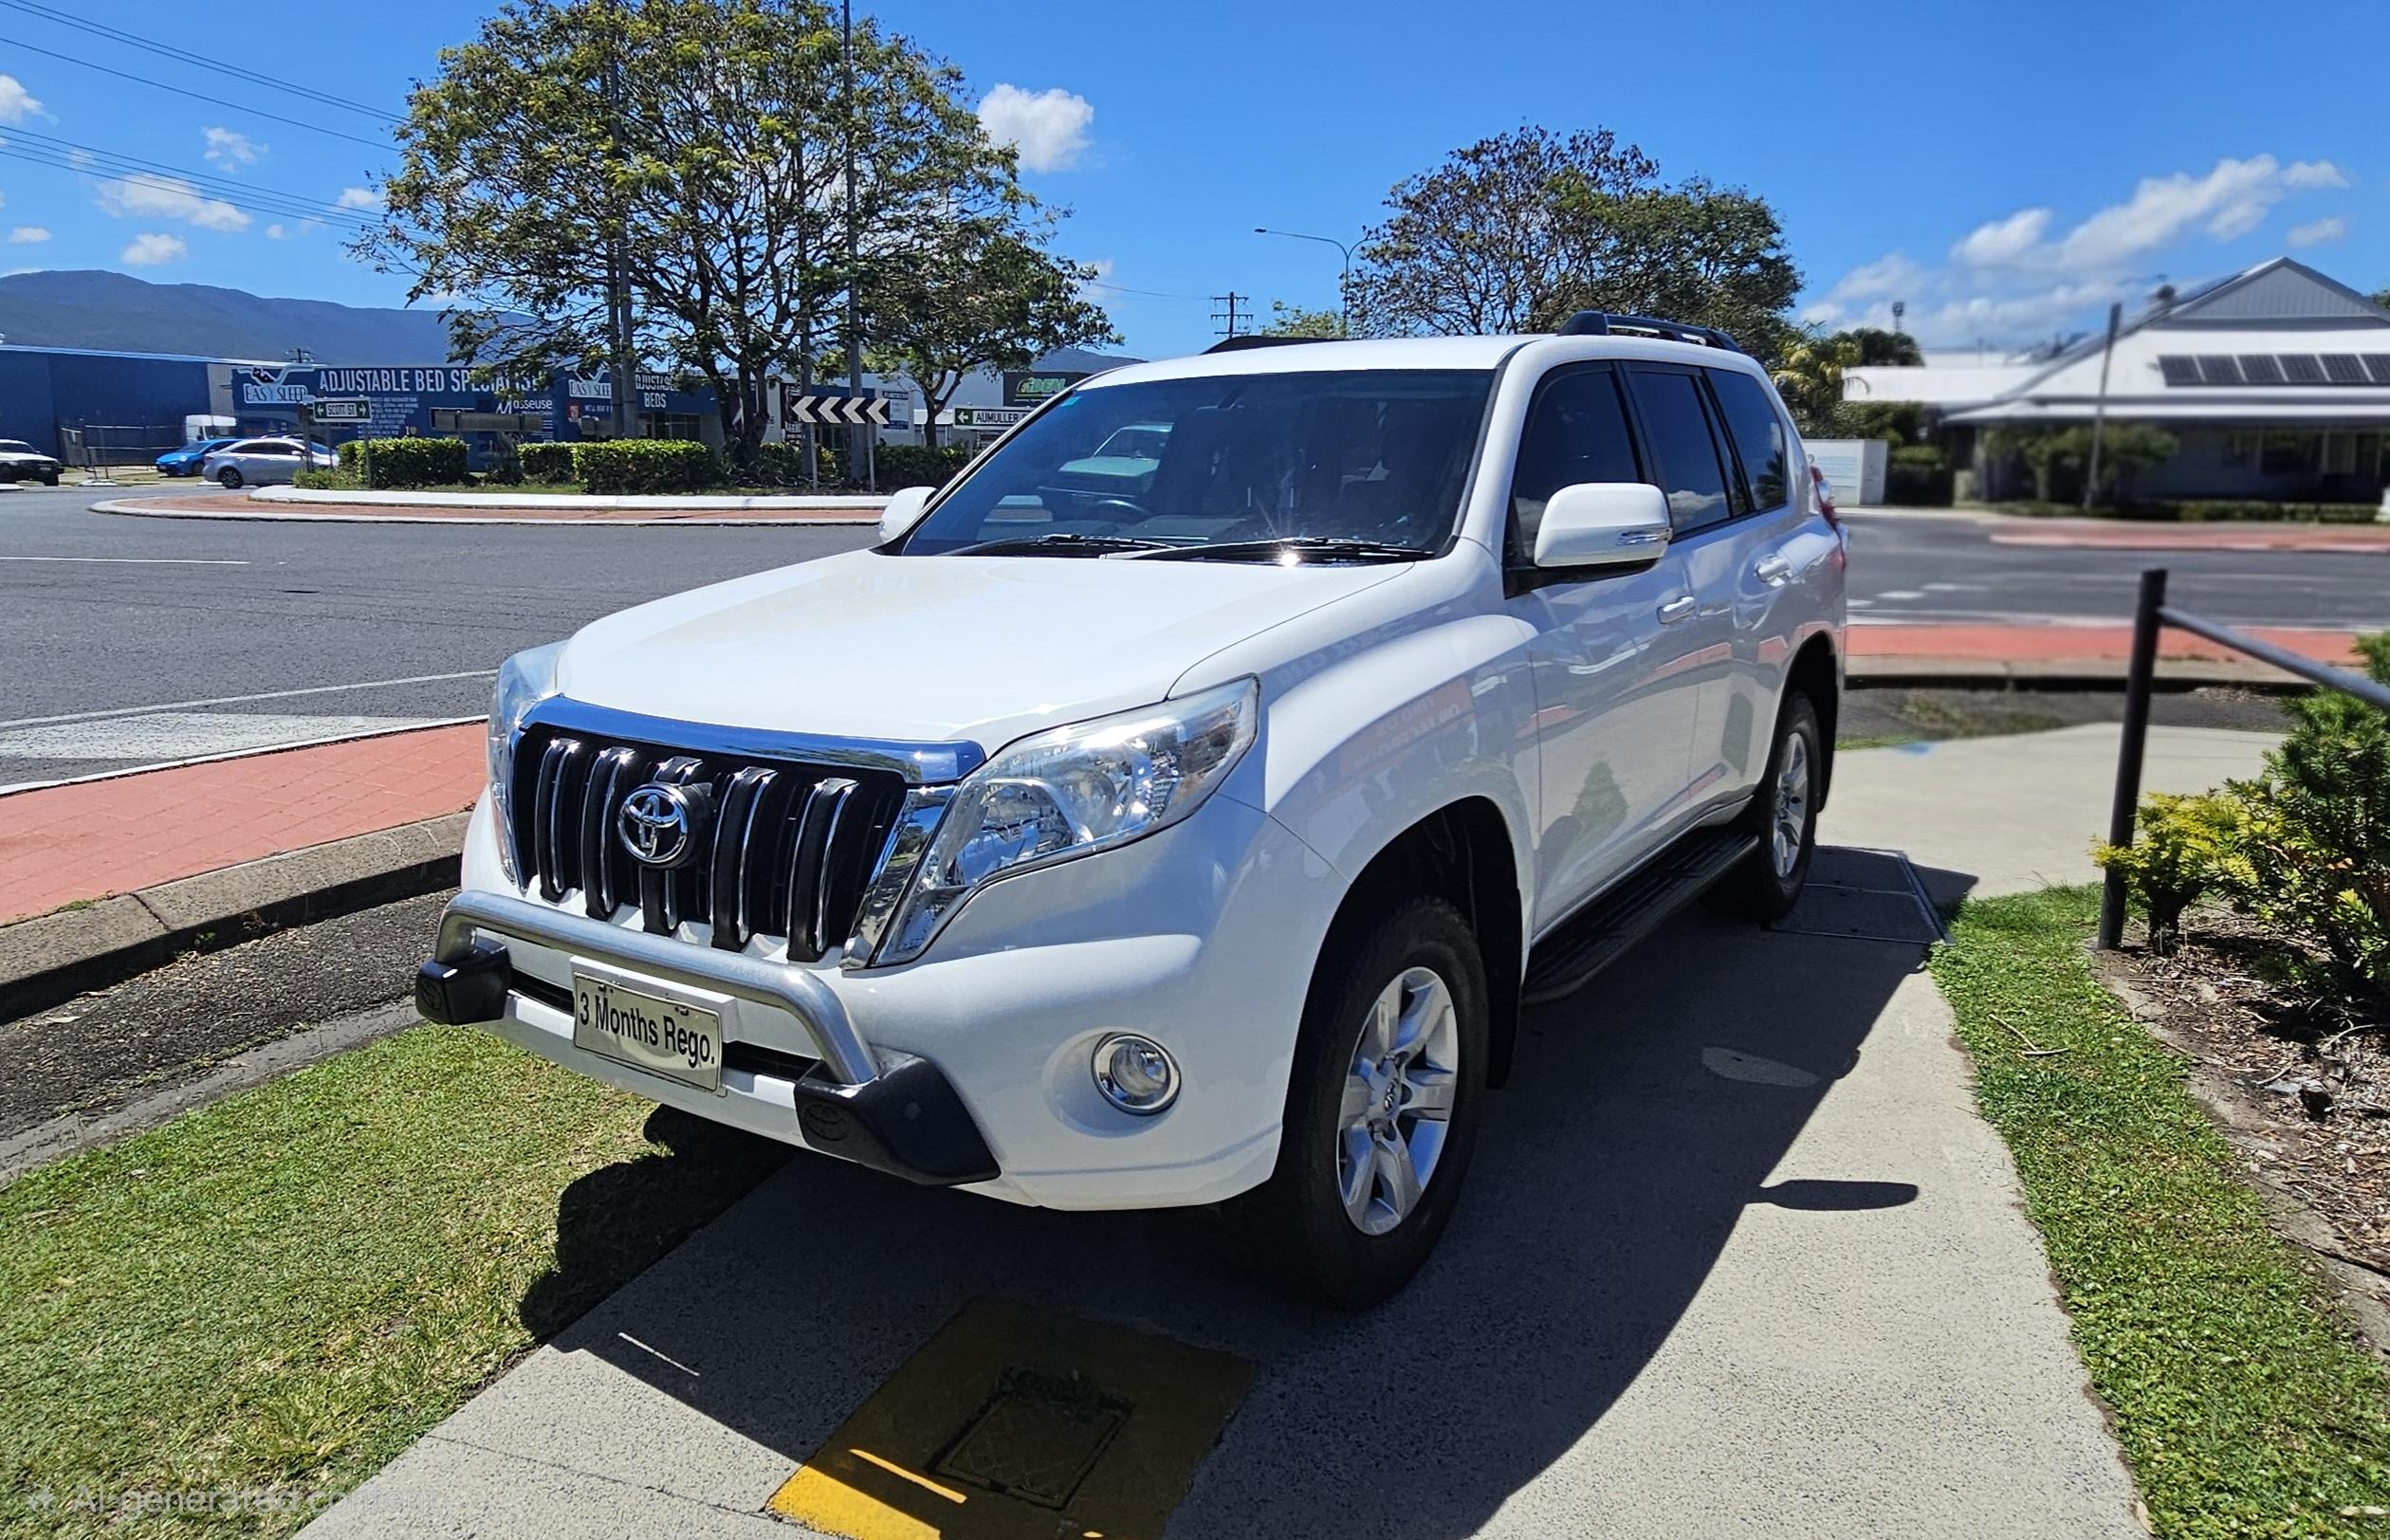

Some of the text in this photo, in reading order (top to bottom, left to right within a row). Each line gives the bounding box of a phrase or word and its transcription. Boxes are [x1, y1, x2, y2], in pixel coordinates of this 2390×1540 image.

[320, 369, 410, 392] ADJUSTABLE
[414, 369, 445, 392] BED
[245, 385, 307, 402] EASY SLEEP
[594, 384, 610, 396] SLEE
[495, 398, 553, 414] Masseuse
[644, 392, 667, 409] BEDS
[327, 404, 345, 415] SCOTT
[975, 412, 1019, 423] AUMULLER
[579, 991, 715, 1069] 3 Months Rego.
